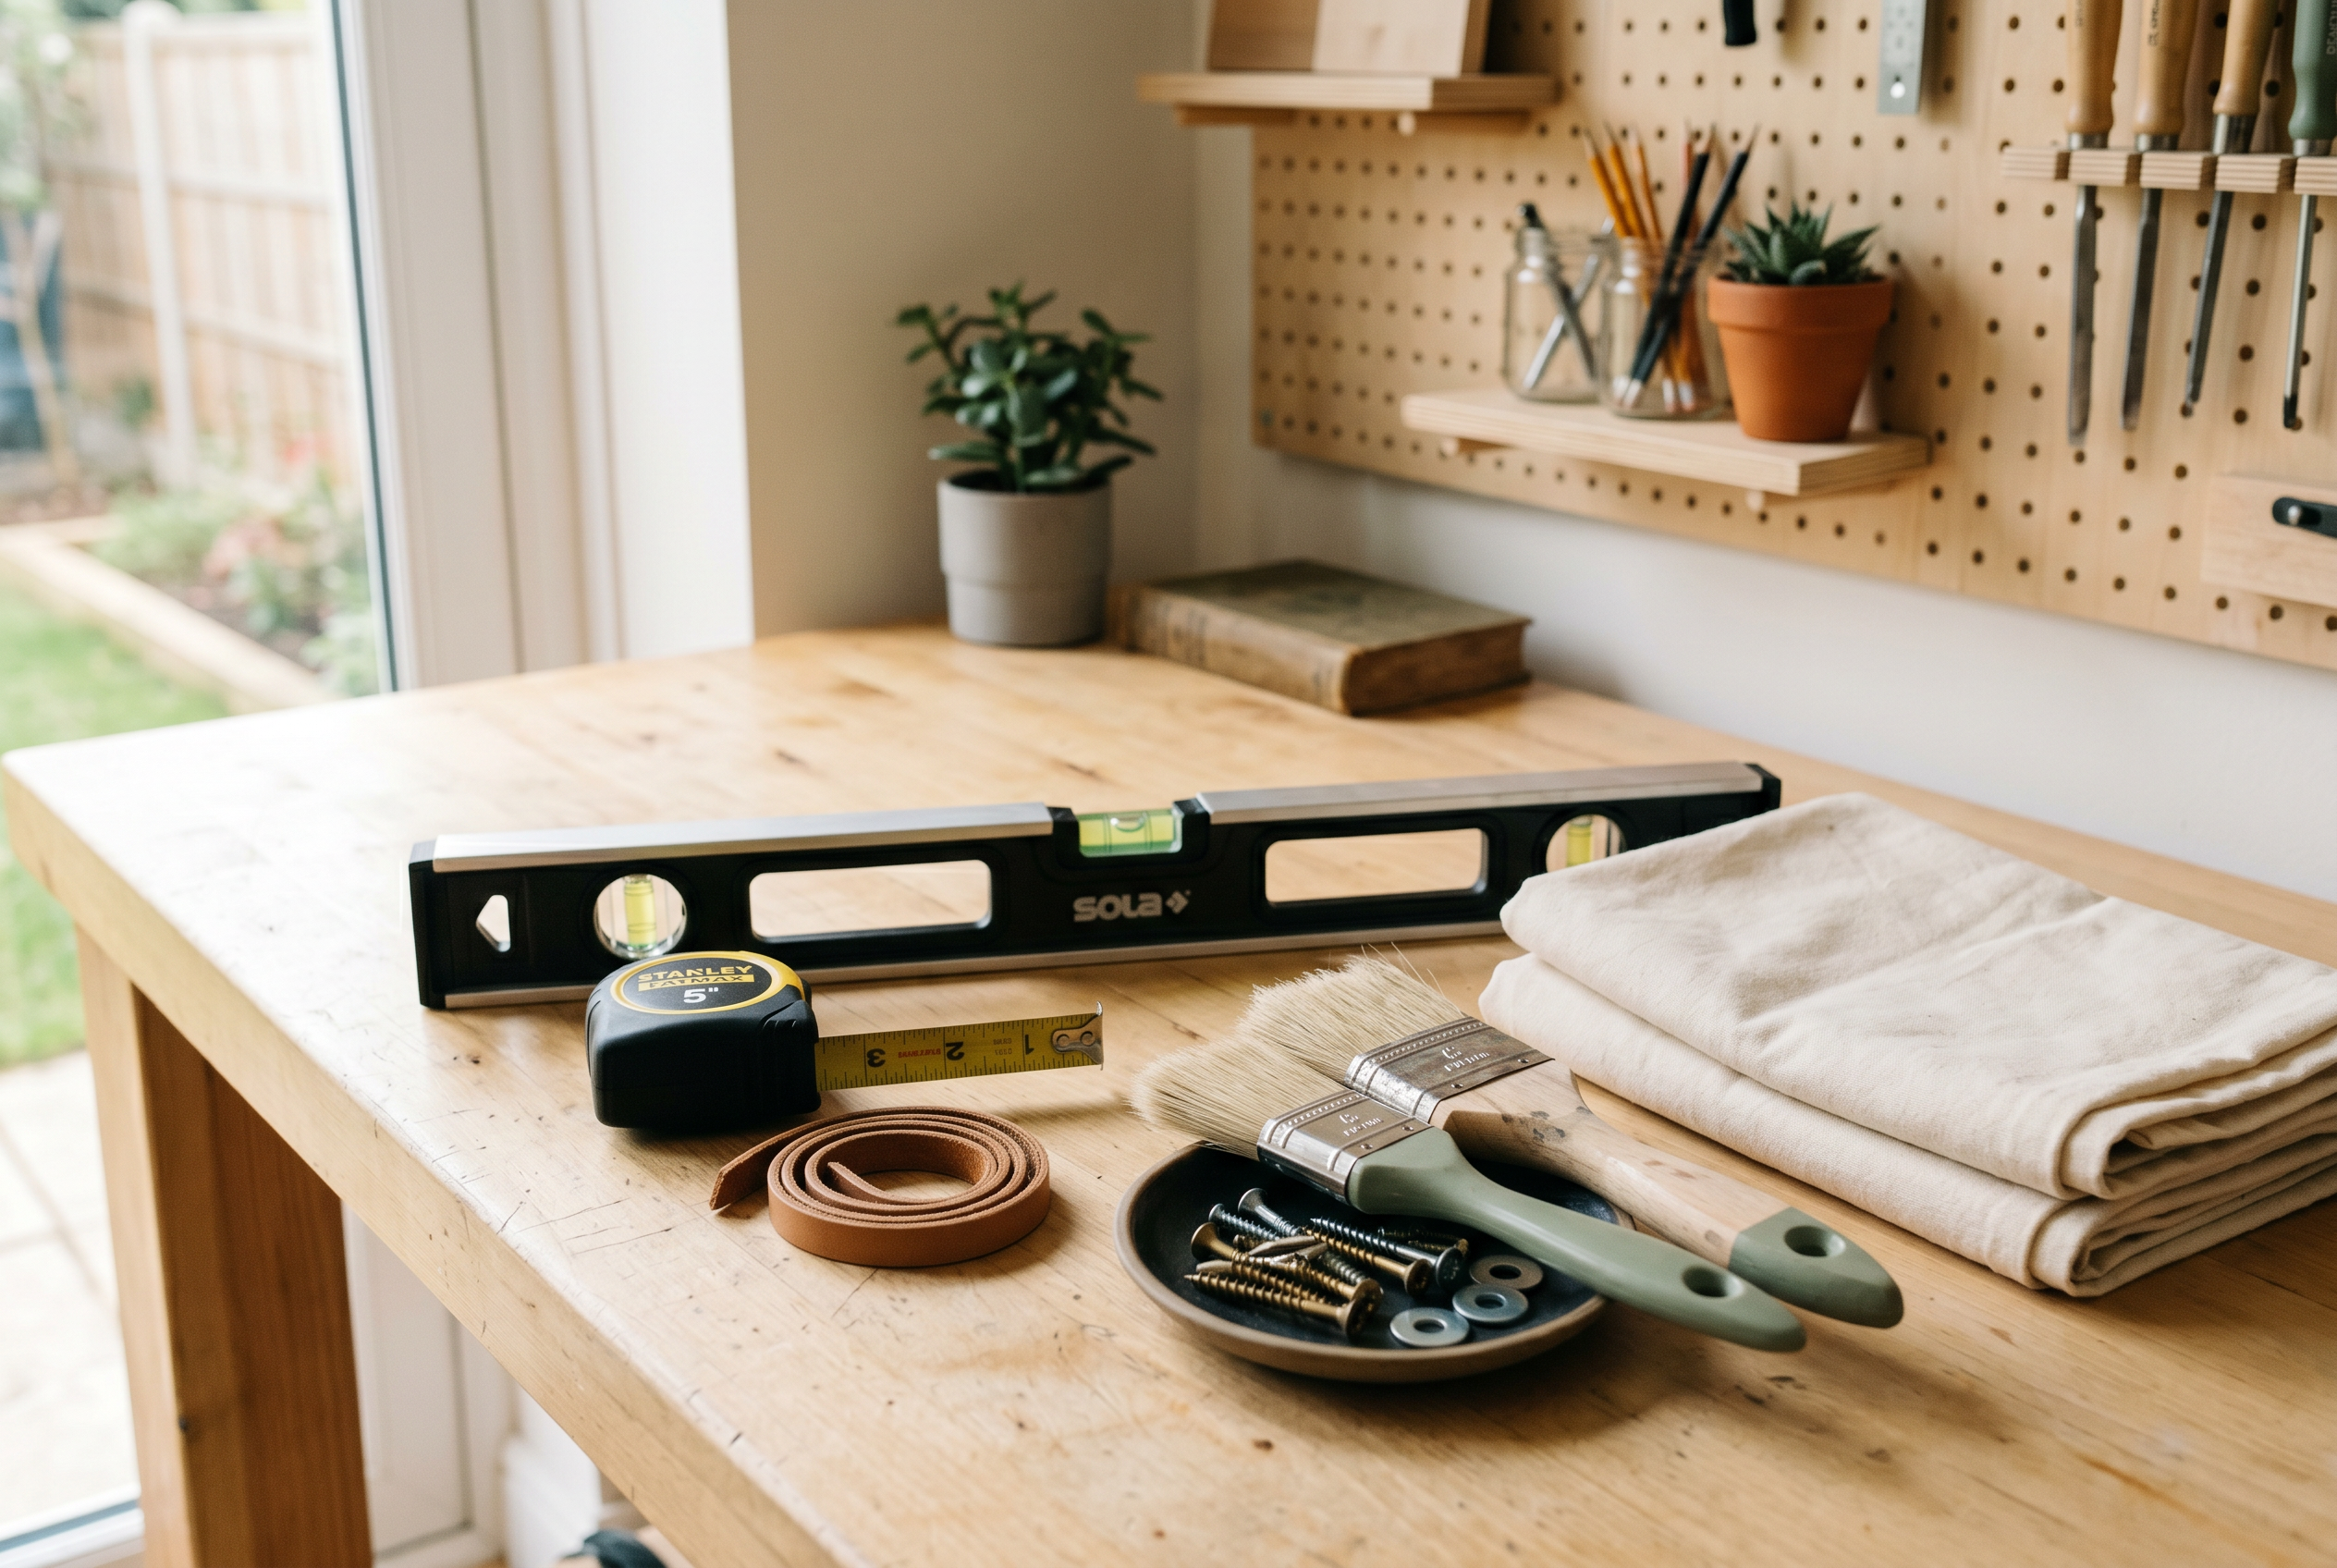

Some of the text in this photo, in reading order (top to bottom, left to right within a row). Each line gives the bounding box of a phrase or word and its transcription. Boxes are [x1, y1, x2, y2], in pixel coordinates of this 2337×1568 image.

[638, 965, 752, 982] STANLEY
[649, 974, 744, 988] FATMAX
[683, 986, 719, 1004] 5"
[945, 1041, 965, 1061] 2
[1024, 1034, 1035, 1056] 1
[866, 1048, 887, 1068] 3
